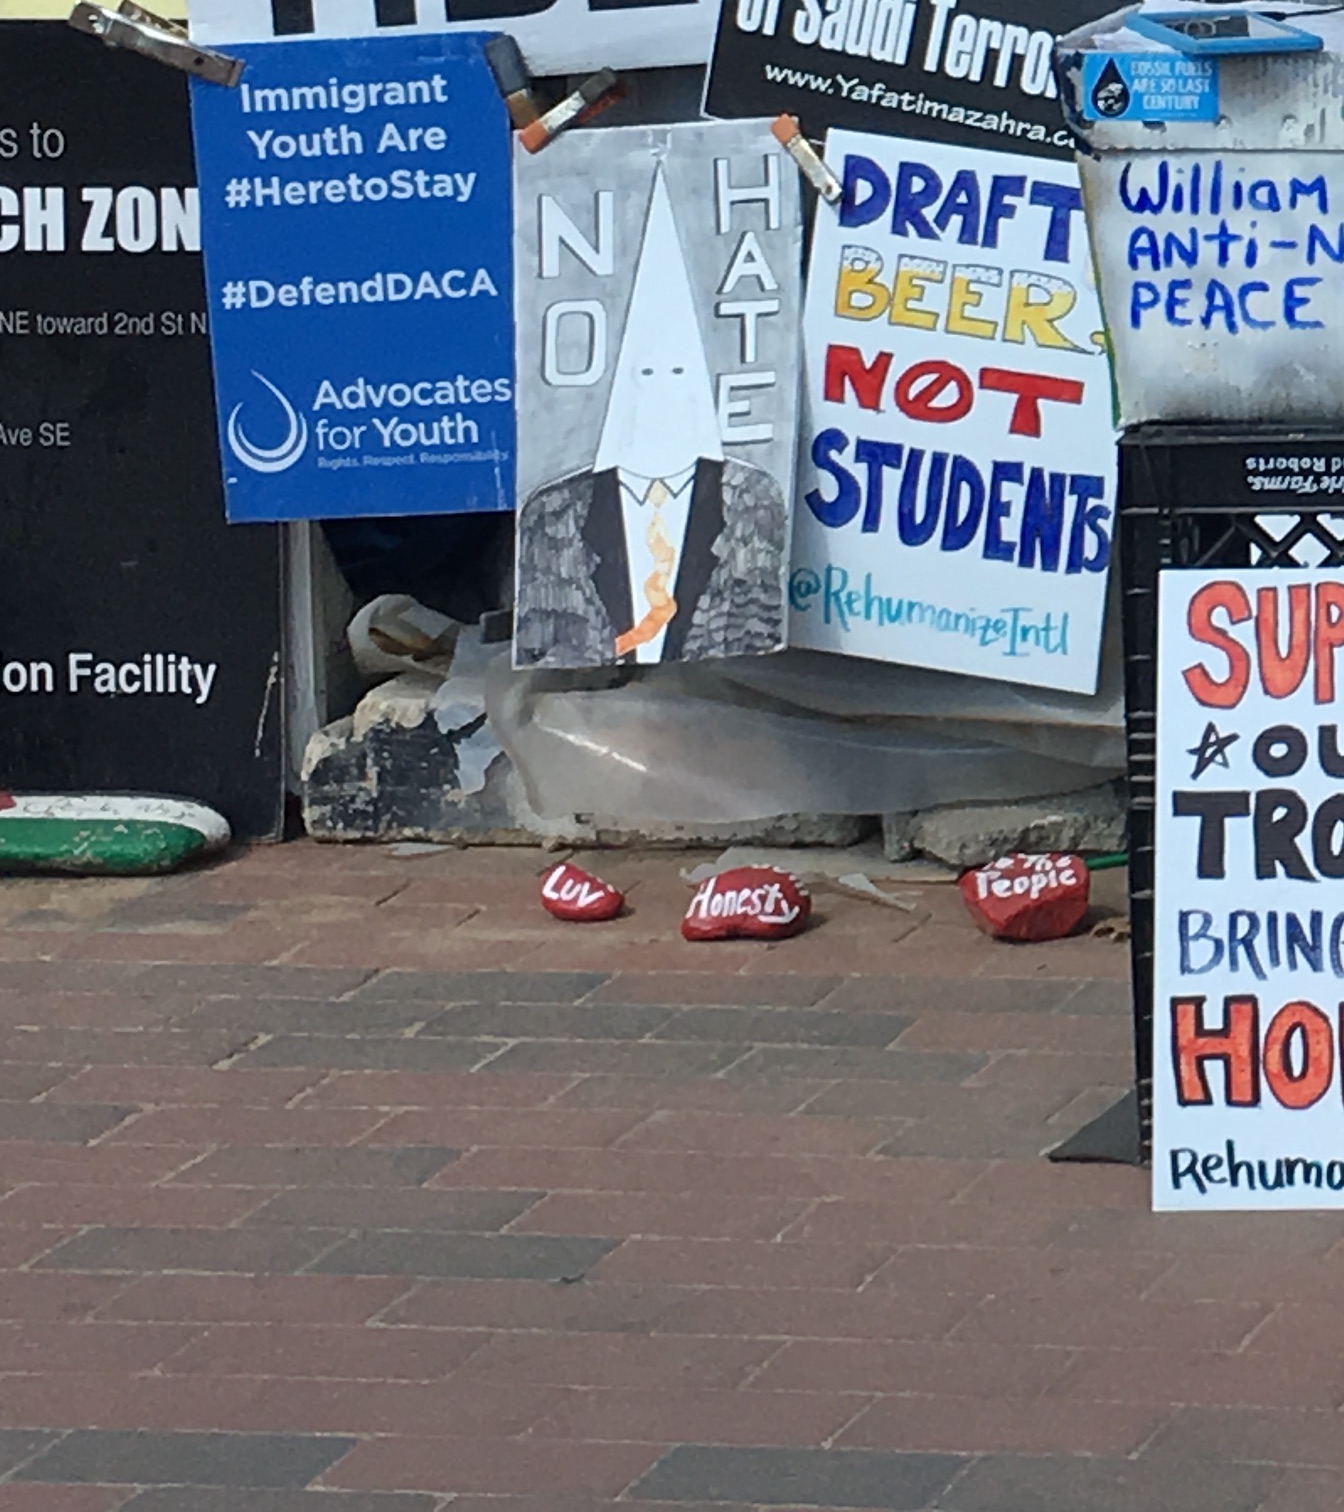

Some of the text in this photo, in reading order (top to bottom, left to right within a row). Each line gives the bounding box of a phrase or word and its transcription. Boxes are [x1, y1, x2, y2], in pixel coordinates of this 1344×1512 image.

[1131, 60, 1213, 77] FOSSIL FUELS
[1131, 78, 1211, 93] ARE SO LAST
[240, 73, 449, 115] Immigrant
[1142, 94, 1201, 110] CENTURY
[30, 121, 65, 159] to
[246, 124, 447, 160] Youth Are
[225, 169, 477, 209] #HeretoStay
[836, 153, 1086, 264] DRAFT
[81, 185, 202, 253] ZON
[221, 268, 499, 310] #DefendDACA
[1130, 275, 1325, 336] PEACE
[36, 311, 109, 336] toward
[114, 311, 155, 336] 2nd
[160, 311, 185, 336] St
[313, 375, 512, 411] Advocates
[823, 343, 1086, 438] NOT
[39, 422, 71, 448] SE
[315, 414, 479, 451] for Youth
[1246, 456, 1327, 473] Roberts
[805, 428, 1110, 576] STUDENTS
[787, 566, 1069, 657] @RehumanizeIntl
[68, 652, 217, 705] Facility
[685, 876, 800, 924] Honesty
[974, 869, 1077, 900] People
